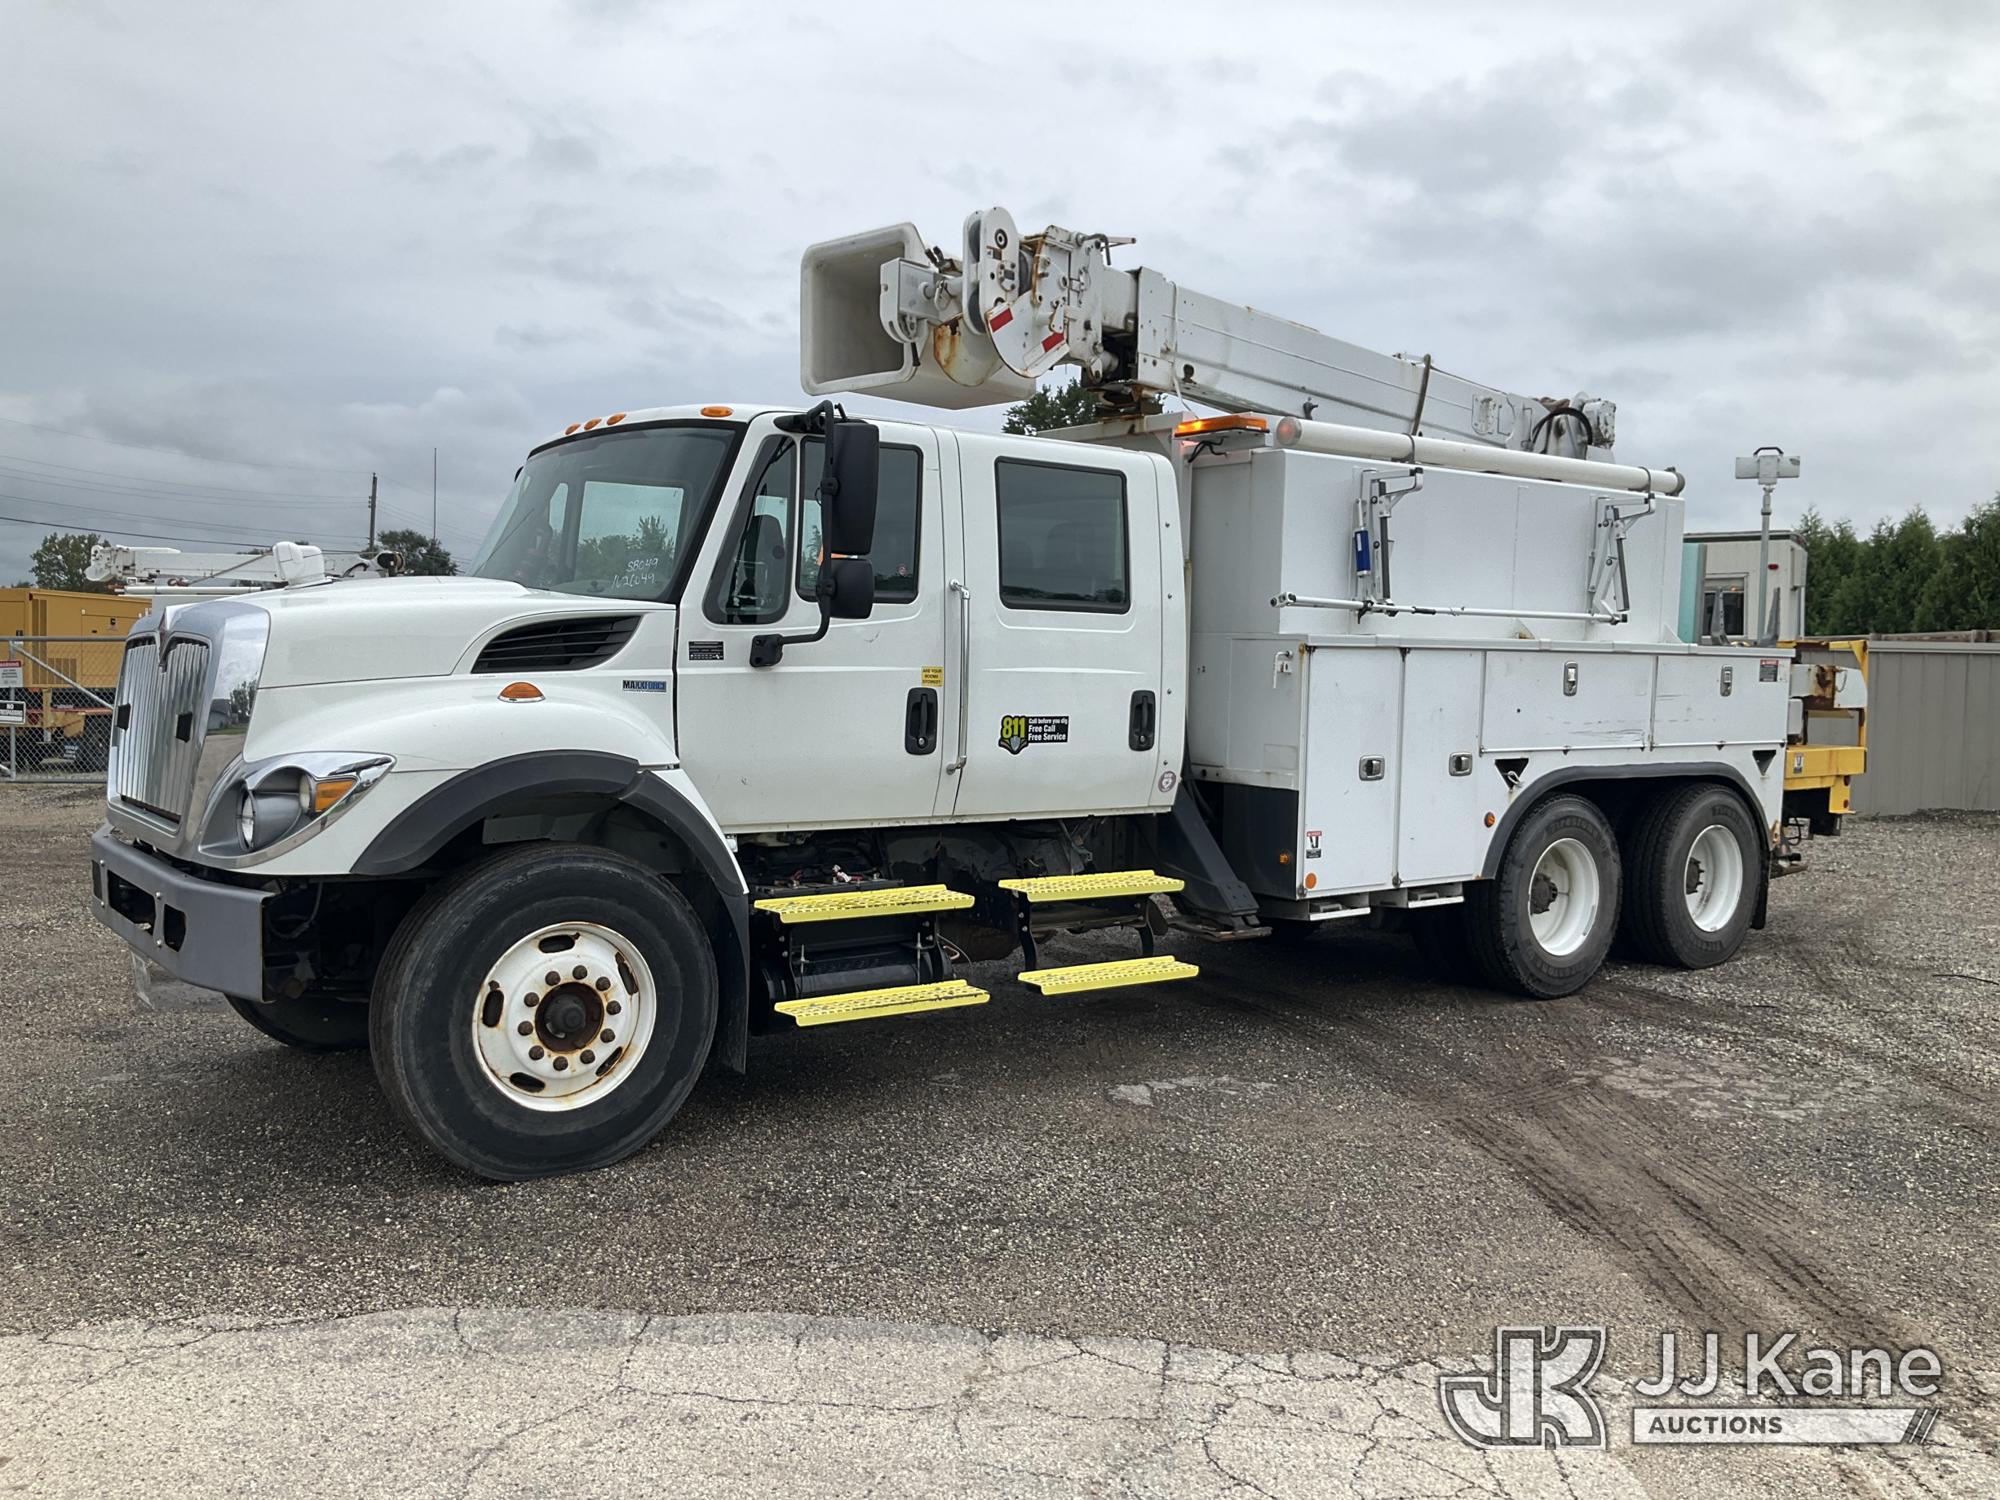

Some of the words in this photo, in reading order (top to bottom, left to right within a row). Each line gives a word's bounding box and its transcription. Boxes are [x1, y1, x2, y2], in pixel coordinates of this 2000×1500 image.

[1002, 716, 1026, 739] 811
[1043, 724, 1056, 732] Call
[1028, 733, 1042, 741] Free
[1043, 732, 1066, 741] Service
